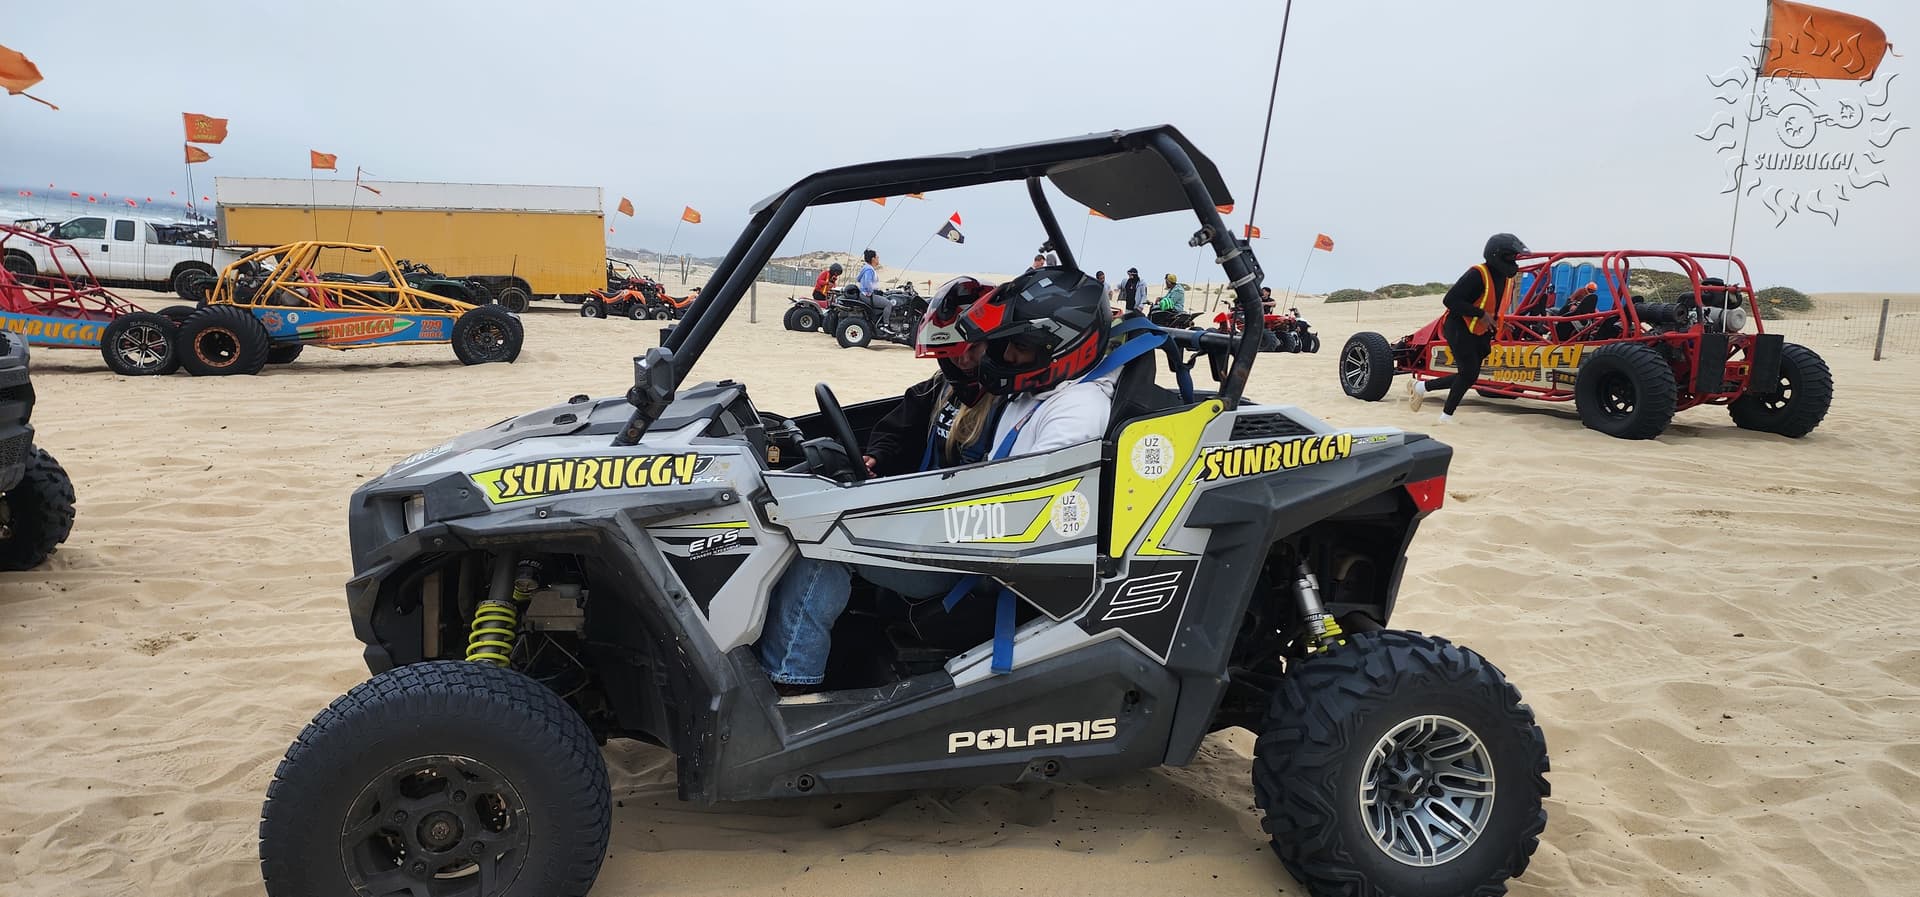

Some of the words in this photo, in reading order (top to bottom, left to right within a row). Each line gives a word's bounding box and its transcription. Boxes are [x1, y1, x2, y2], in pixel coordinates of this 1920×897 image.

[0, 317, 105, 342] NBUGG
[1444, 343, 1584, 368] SBUGGY
[1493, 370, 1536, 383] WOODY
[1144, 438, 1159, 447] UZ
[1205, 433, 1353, 481] SUNBUGGY
[500, 453, 698, 497] SUNBUGGY
[1144, 465, 1163, 475] 210
[1062, 495, 1075, 506] UZ
[943, 503, 1006, 544] UZ210
[1062, 522, 1080, 533] 210
[689, 529, 739, 552] EPS
[948, 717, 1117, 753] POLARIS
